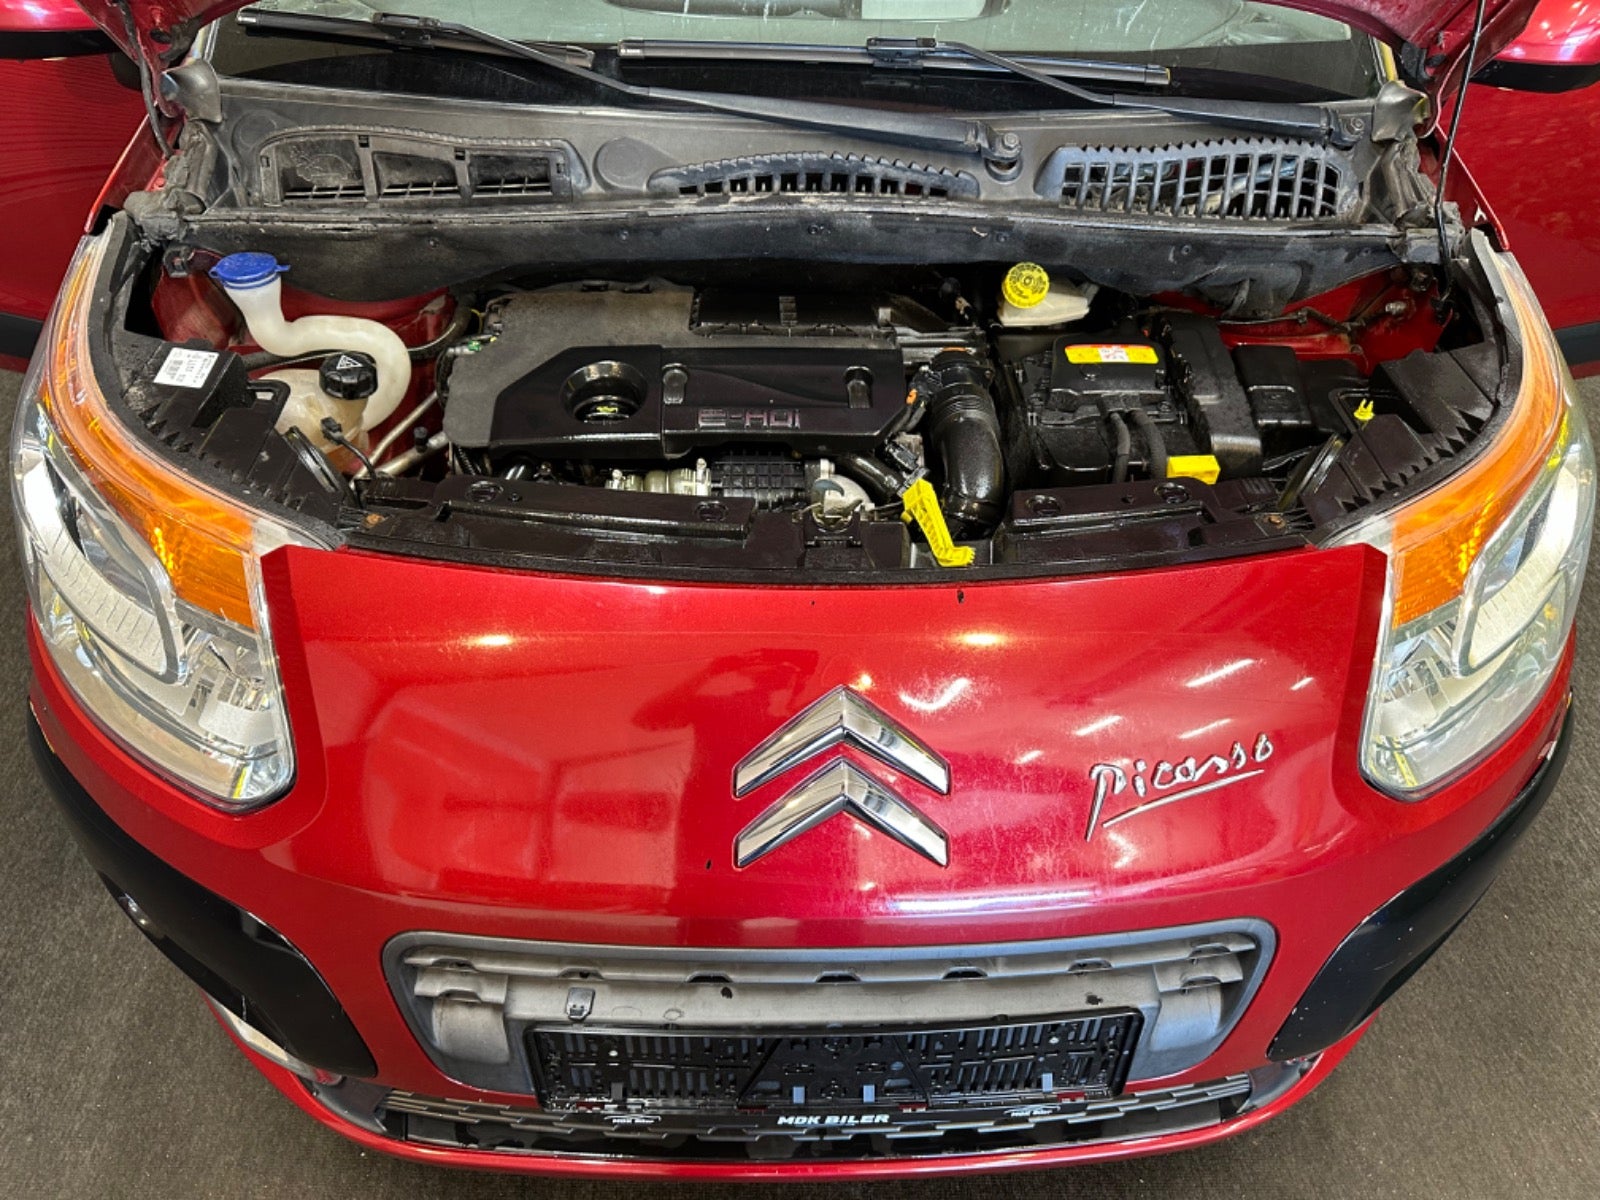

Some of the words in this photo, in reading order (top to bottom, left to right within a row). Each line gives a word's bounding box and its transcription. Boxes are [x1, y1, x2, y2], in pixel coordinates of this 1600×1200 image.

[1085, 732, 1274, 842] Picasso
[777, 1115, 821, 1125] MDK
[824, 1113, 890, 1125] BILER
